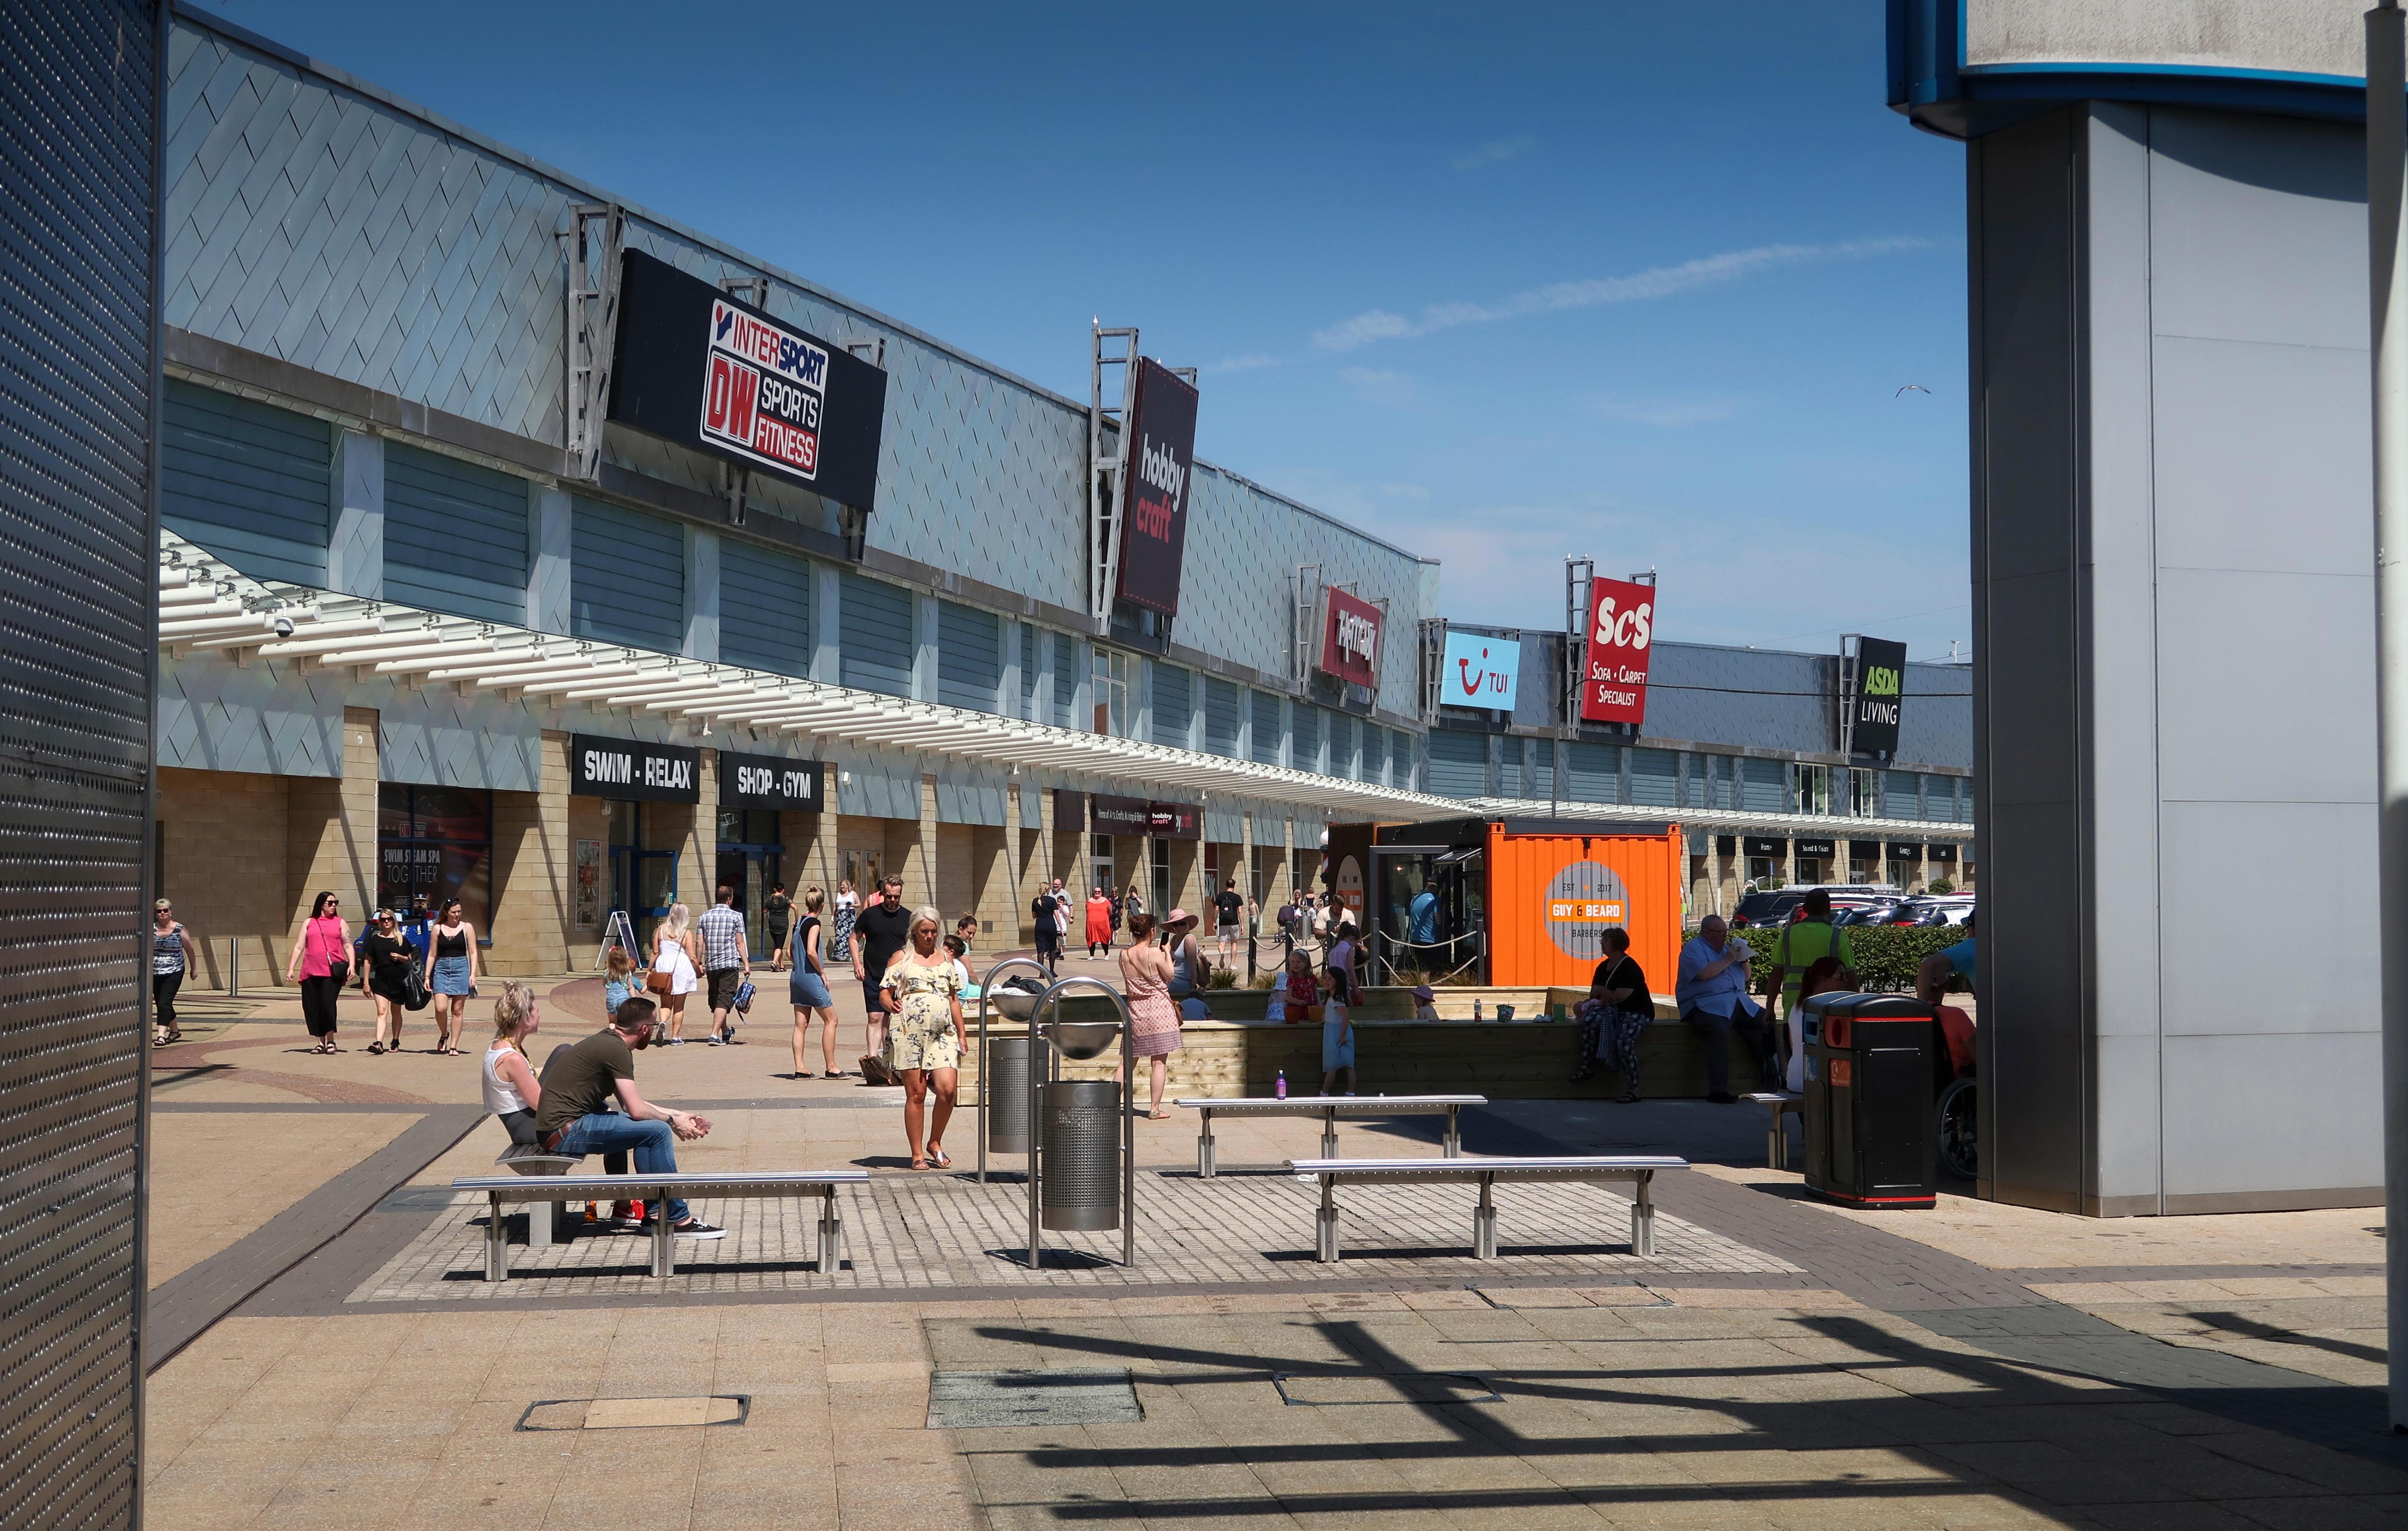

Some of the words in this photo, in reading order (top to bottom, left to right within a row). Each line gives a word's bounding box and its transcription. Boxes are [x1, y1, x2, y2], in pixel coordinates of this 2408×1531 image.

[733, 313, 825, 387] INTERSPORT
[707, 357, 758, 441] DW
[761, 376, 818, 428] SPORTS
[756, 417, 814, 467] FITNESS
[1141, 433, 1185, 512] hobby
[1137, 493, 1171, 544] craft
[1595, 597, 1651, 650] ScS
[1489, 672, 1508, 694] TUI
[1865, 666, 1898, 695] ASDA
[1861, 701, 1898, 725] LIVING
[585, 750, 631, 784] SWIM
[645, 756, 691, 790] RELAX
[738, 766, 773, 796] SHOP
[783, 771, 811, 799] GYM
[384, 849, 403, 863] SWIM
[428, 850, 440, 864] SPA
[387, 865, 438, 883] TOGTHER
[1553, 904, 1573, 916] GUY
[1577, 905, 1583, 916] &
[1586, 905, 1620, 917] BEARD
[1572, 929, 1603, 938] BARBERS
